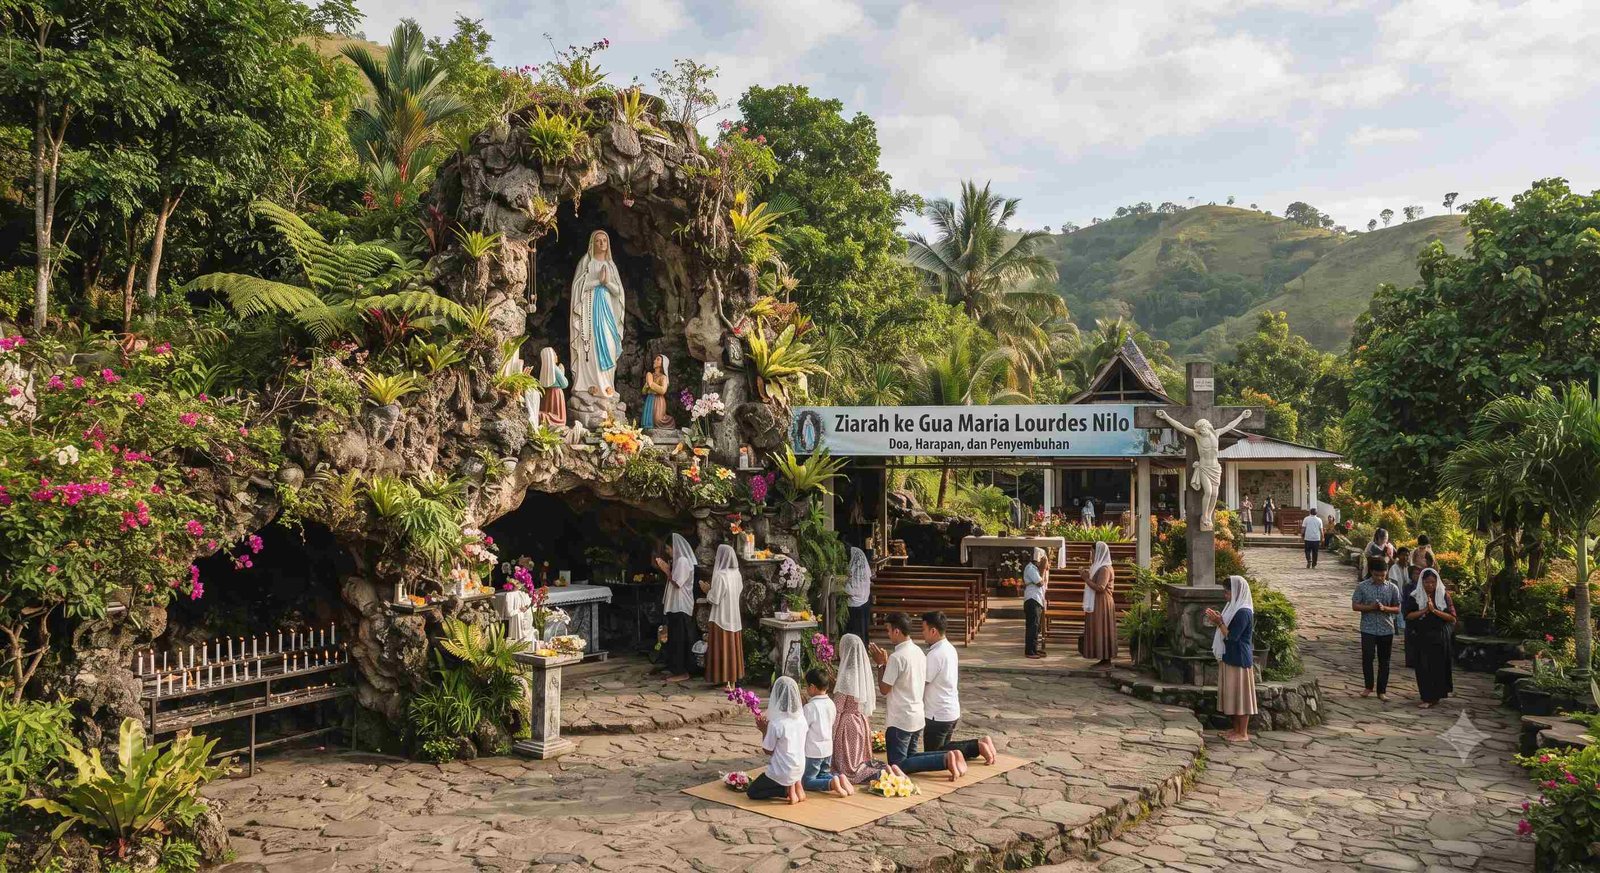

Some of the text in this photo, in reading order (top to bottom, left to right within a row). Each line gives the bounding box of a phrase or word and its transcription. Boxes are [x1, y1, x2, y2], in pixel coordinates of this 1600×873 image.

[835, 412, 1130, 432] Ziarah ke Gua Maria Lourdes Nilo
[889, 437, 1070, 453] Doa, Harapan, dan Penyembuhan
